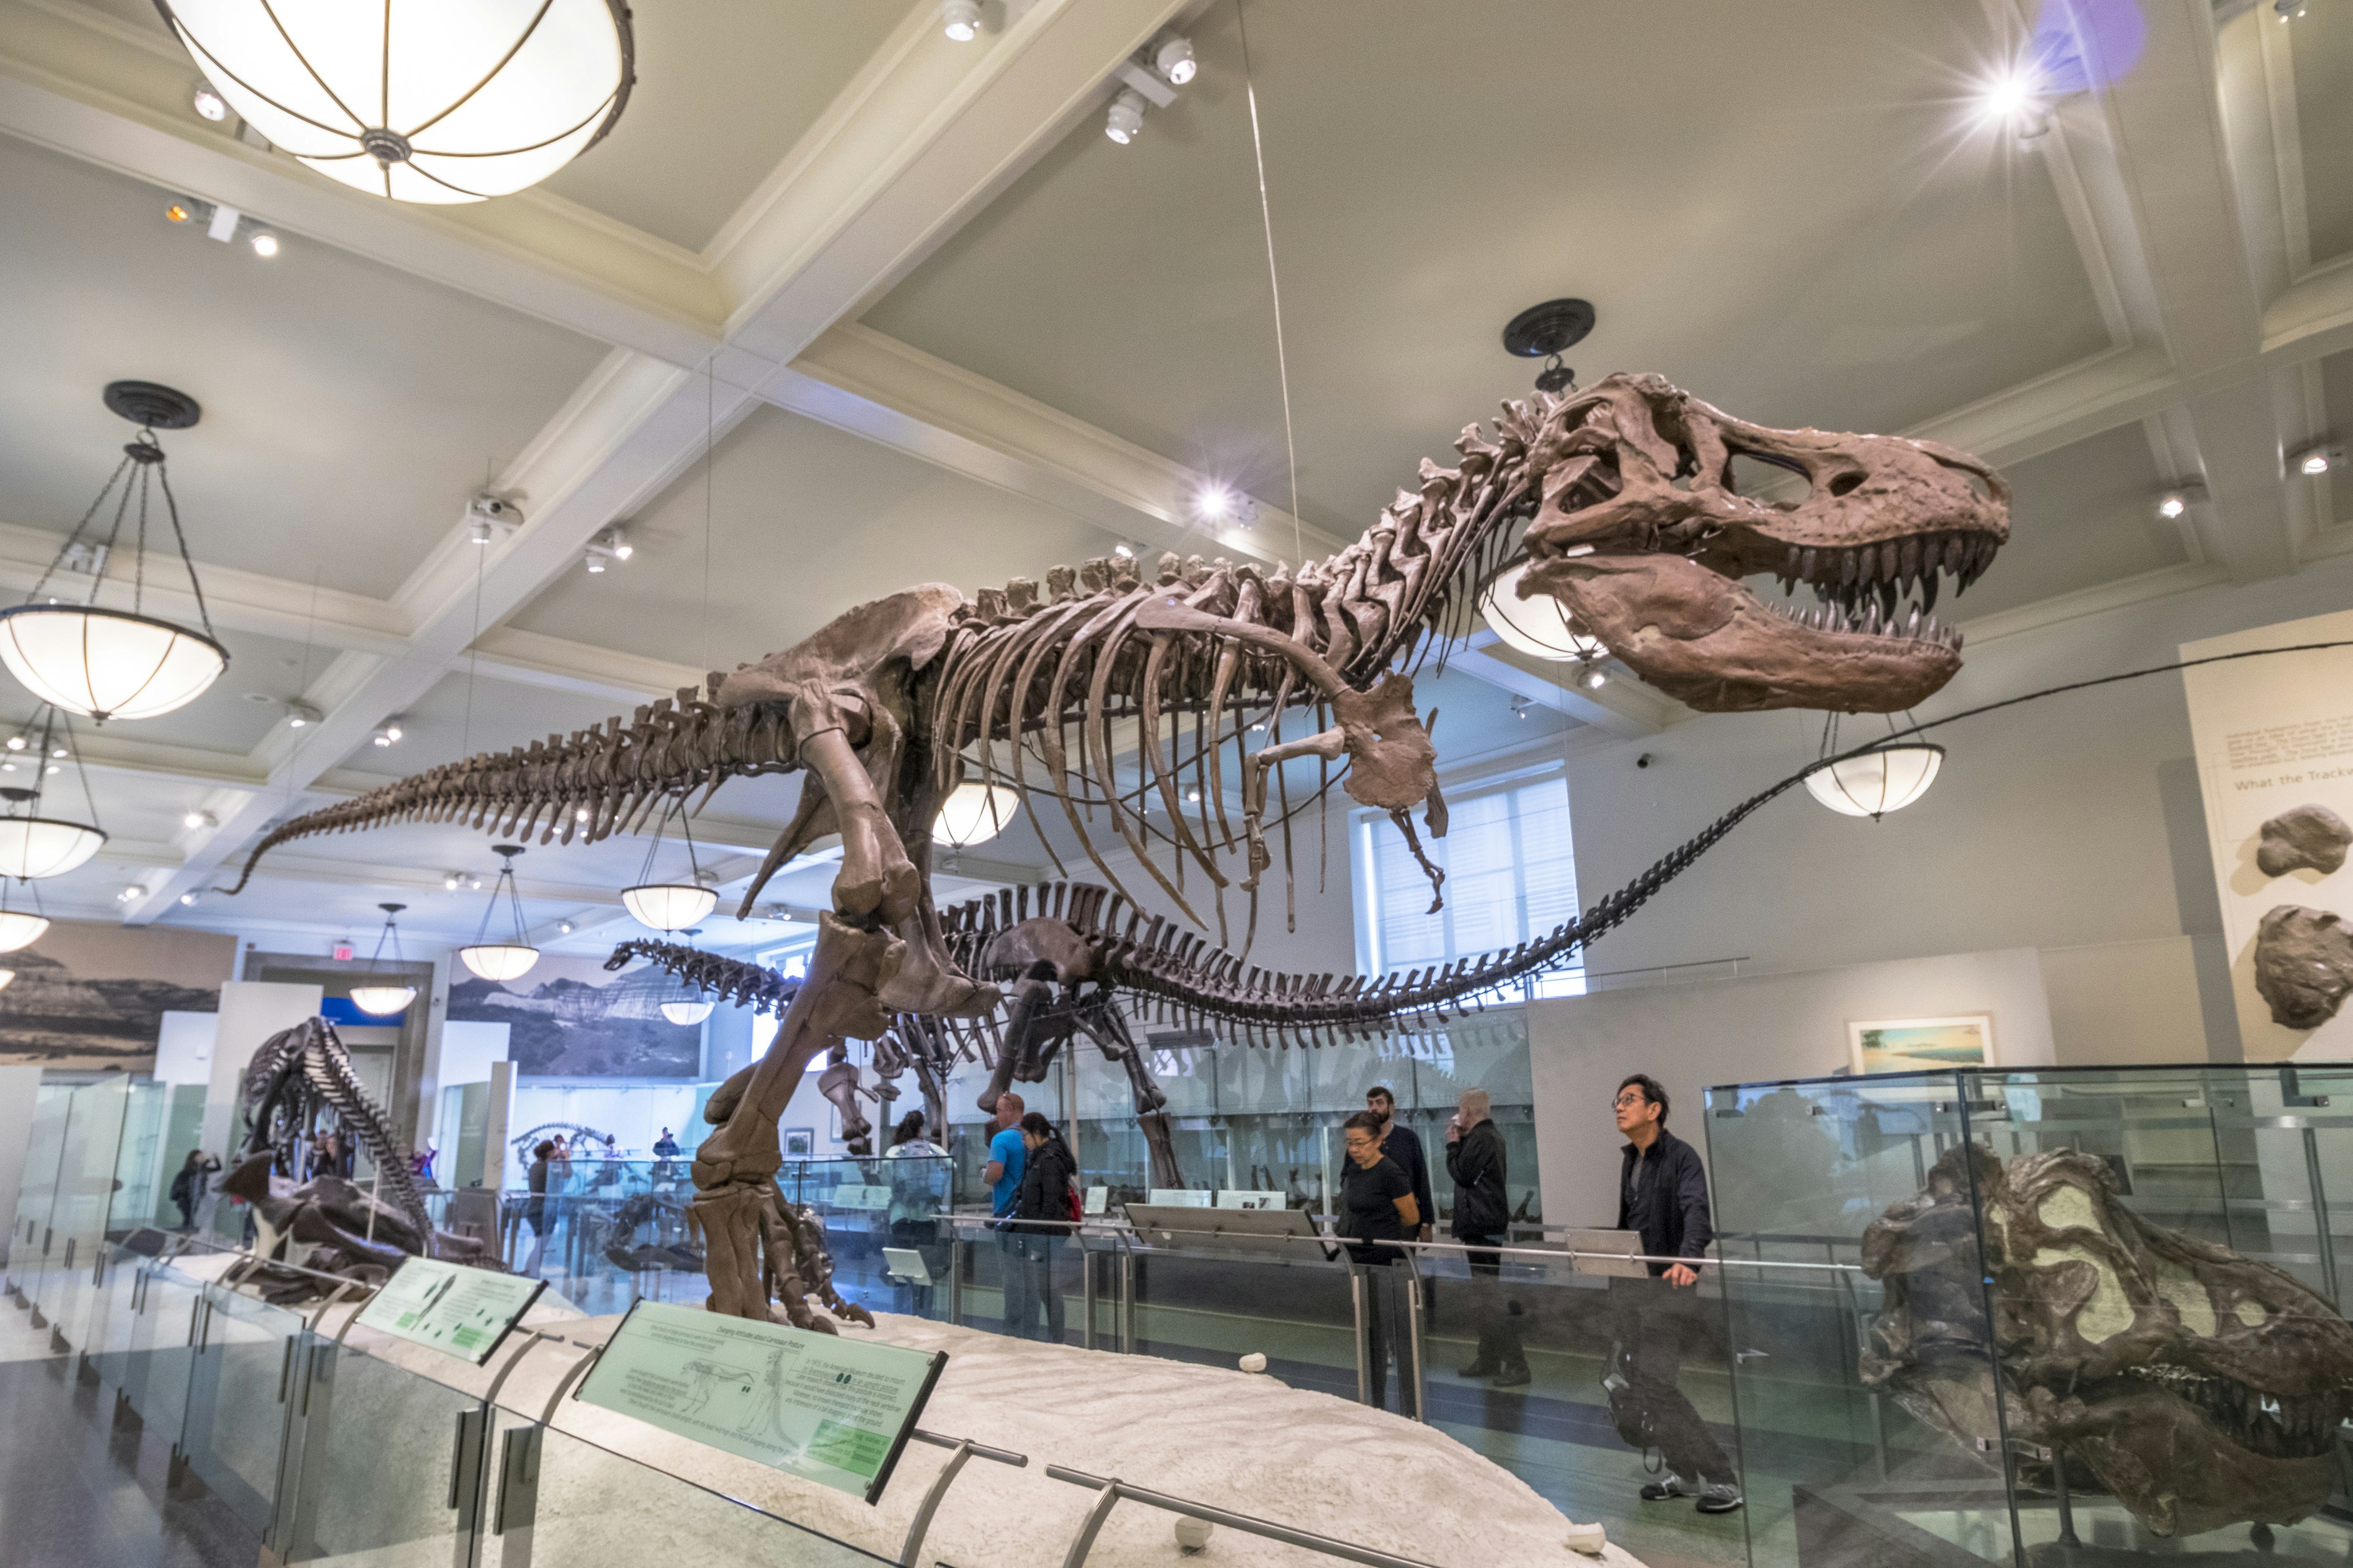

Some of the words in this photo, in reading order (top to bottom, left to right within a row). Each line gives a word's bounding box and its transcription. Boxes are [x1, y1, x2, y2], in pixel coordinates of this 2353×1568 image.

[2234, 778, 2273, 790] What
[2279, 774, 2303, 785] the
[716, 1326, 735, 1336] Changing
[787, 1340, 805, 1349] Posture
